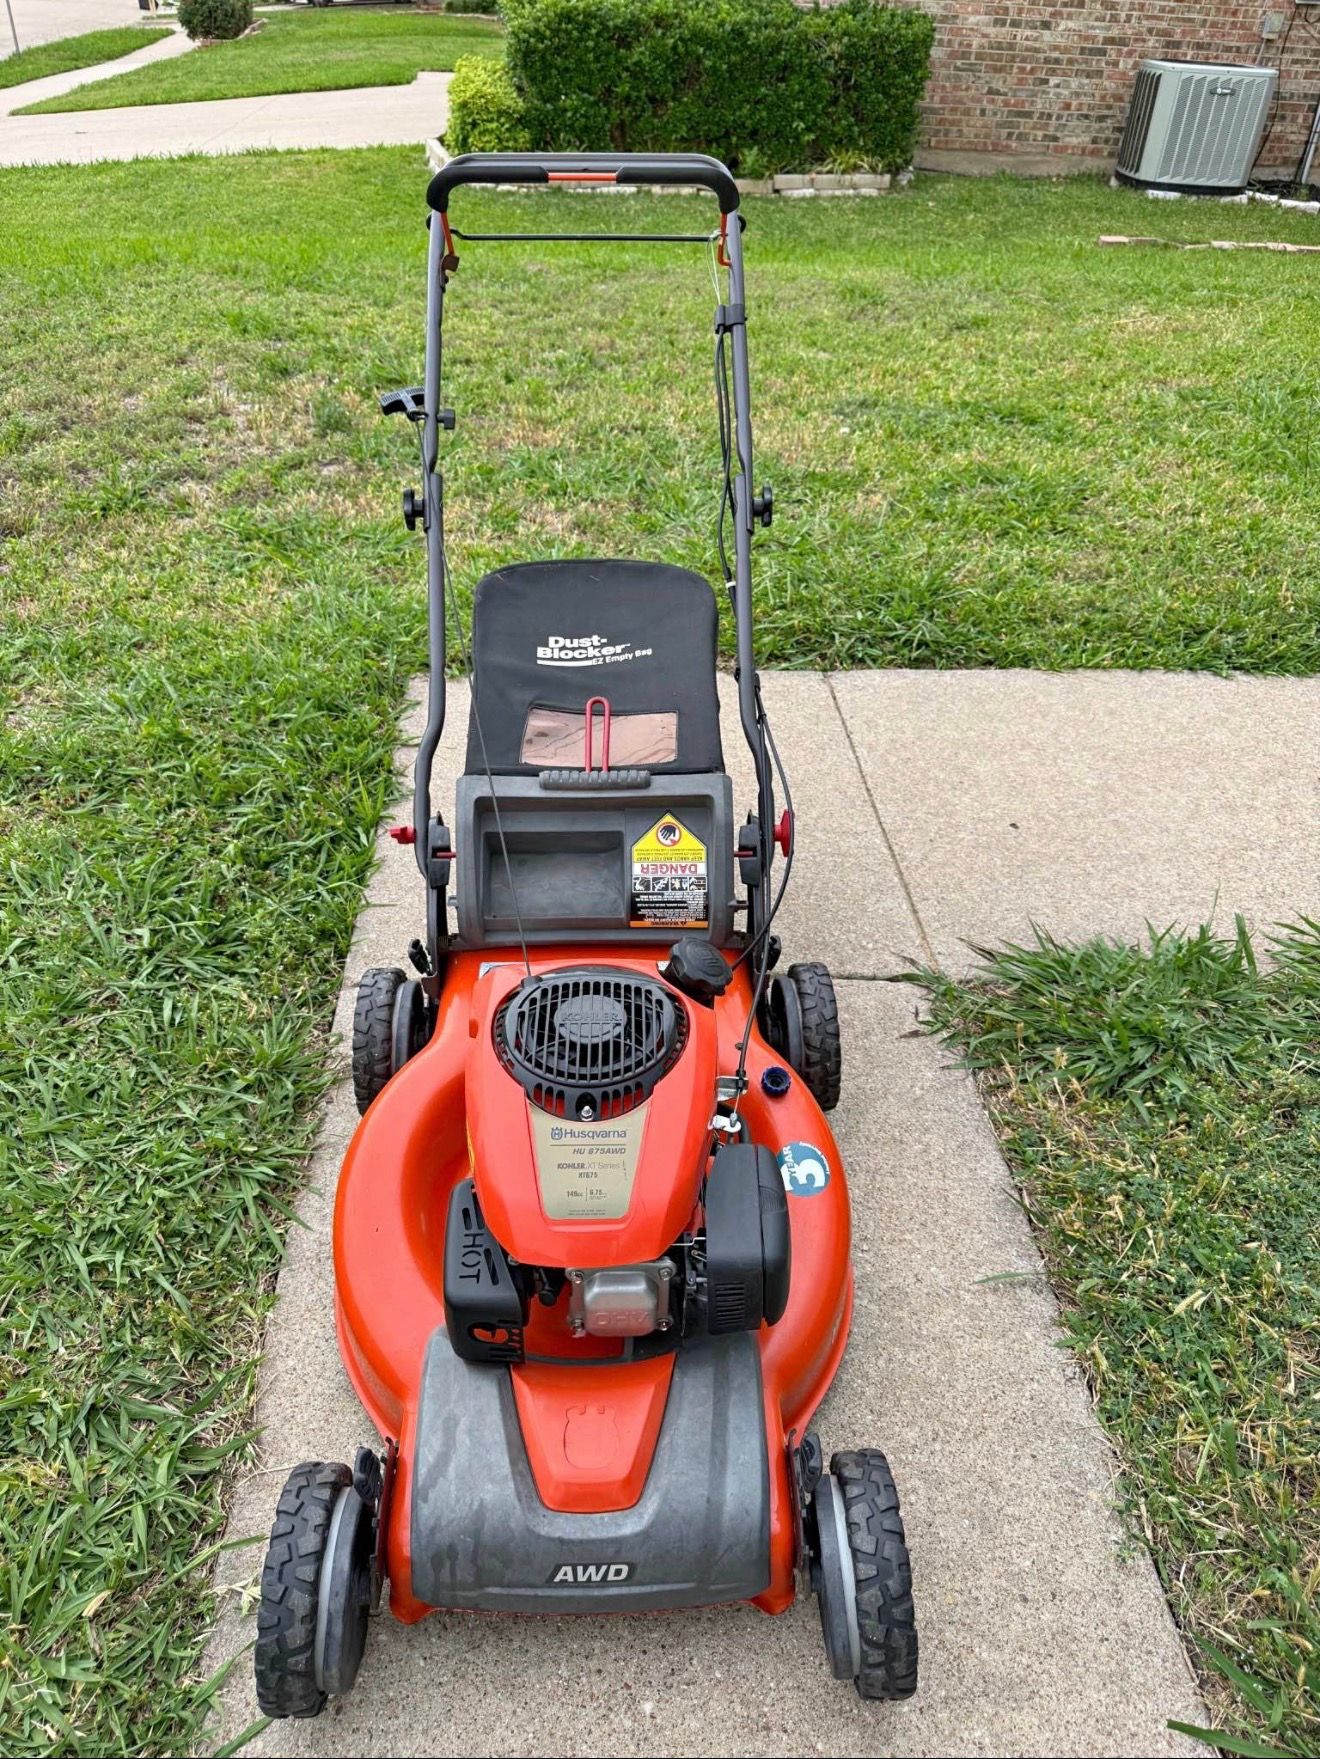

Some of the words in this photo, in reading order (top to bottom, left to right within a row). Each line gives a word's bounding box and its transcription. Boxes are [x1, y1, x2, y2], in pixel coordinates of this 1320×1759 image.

[548, 635, 607, 648] Dust-
[537, 644, 627, 659] Blocker
[605, 652, 634, 664] Empty
[634, 648, 653, 657] Bag
[640, 863, 698, 875] DANGER
[564, 1128, 627, 1140] Husqvarna
[572, 1147, 586, 1155] HU
[782, 1145, 797, 1175] YEAR
[459, 1233, 485, 1284] HOT
[553, 1564, 629, 1582] AWD
